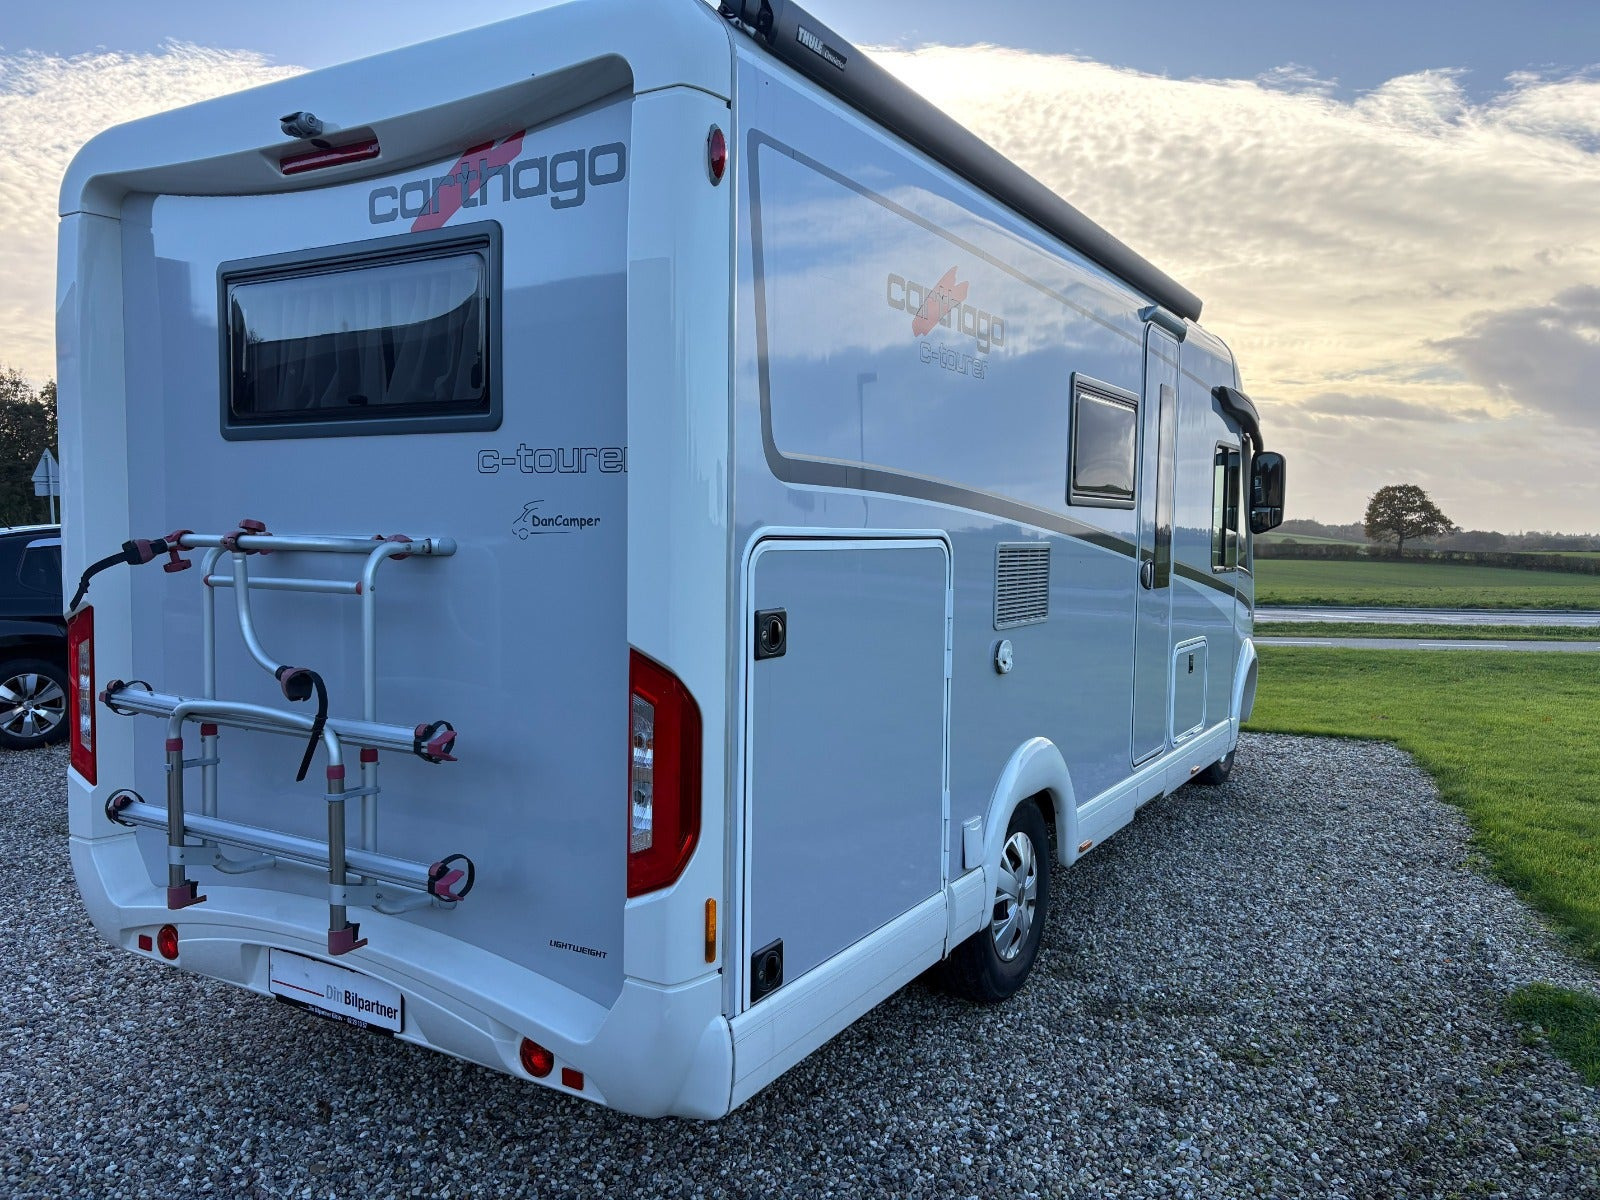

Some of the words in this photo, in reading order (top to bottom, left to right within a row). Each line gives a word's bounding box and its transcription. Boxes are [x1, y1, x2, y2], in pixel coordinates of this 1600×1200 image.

[798, 26, 824, 55] THULE
[368, 141, 627, 225] carthago
[920, 341, 989, 380] c-tourer
[477, 442, 628, 474] c-toure
[532, 514, 600, 530] DanCamper
[549, 939, 608, 959] LIGHTWEIGHT
[344, 989, 399, 1020] Bilpartner
